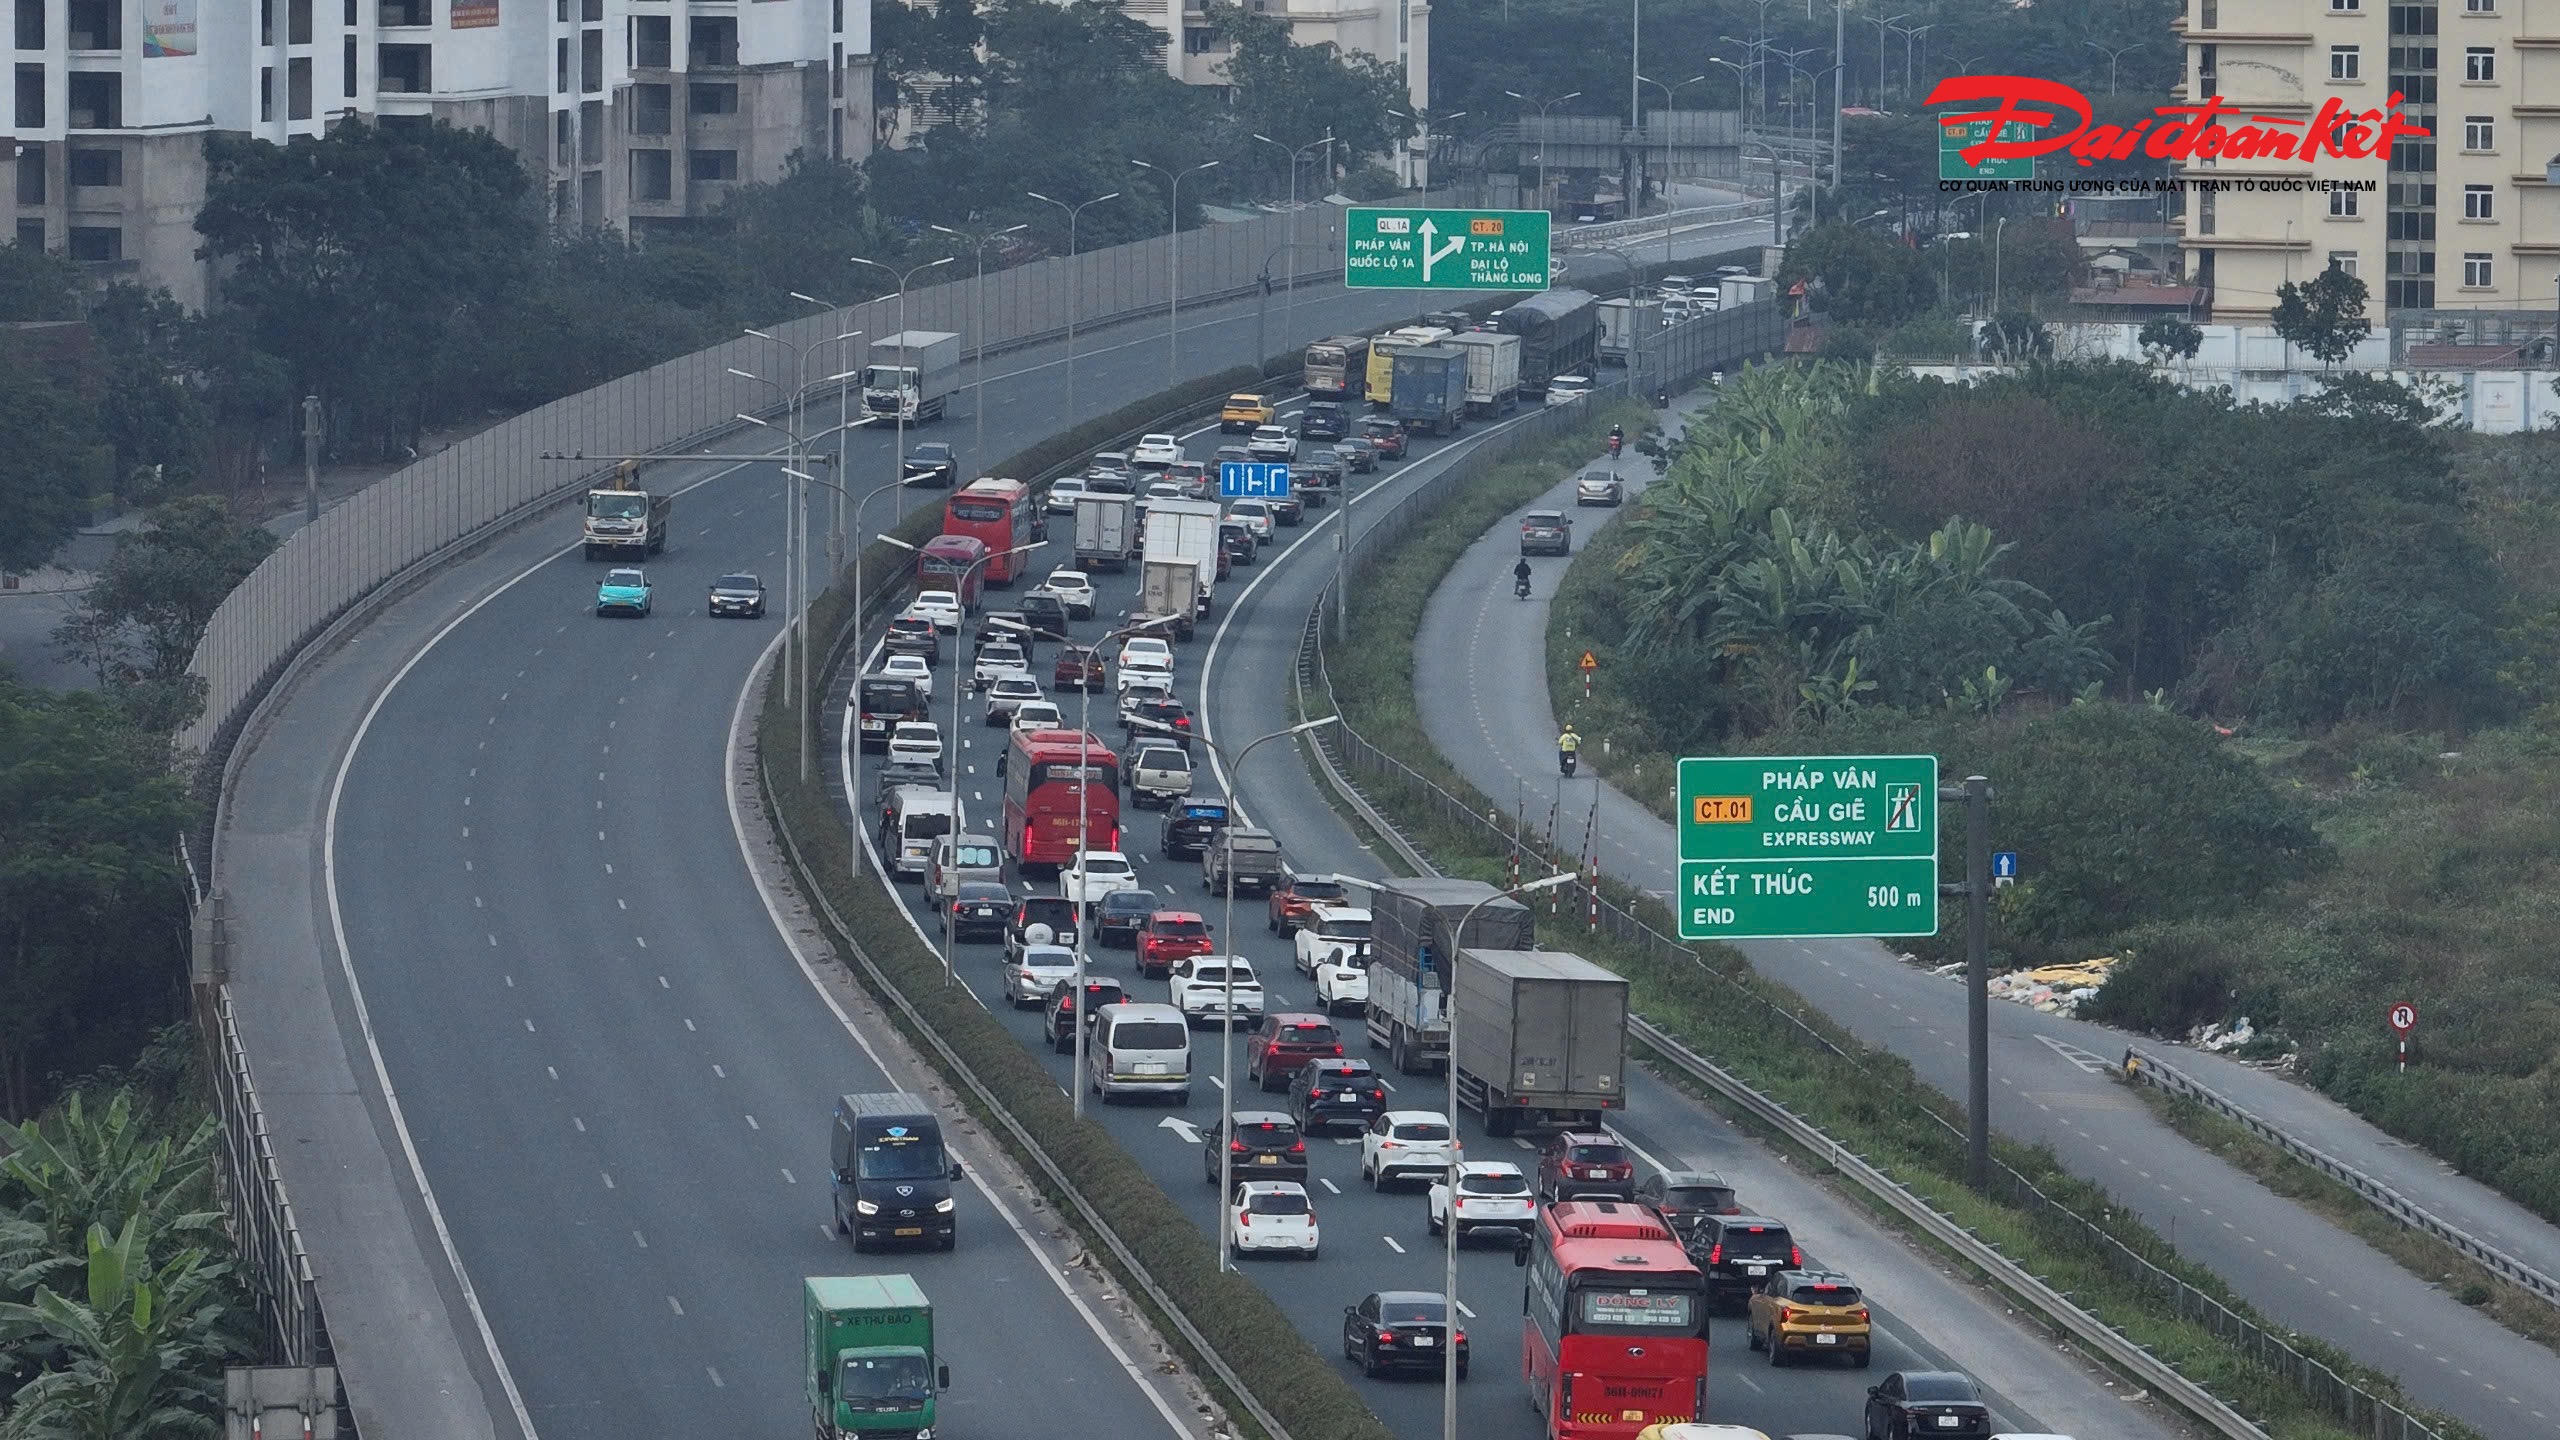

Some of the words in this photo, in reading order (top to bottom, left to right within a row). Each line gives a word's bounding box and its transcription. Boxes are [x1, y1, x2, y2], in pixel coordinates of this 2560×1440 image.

[1355, 237, 1385, 251] PHÁP
[1389, 237, 1411, 251] VÂN
[1509, 240, 1529, 256] NỘI
[1349, 253, 1381, 268] QUỐC
[1383, 255, 1398, 270] LỘ
[1401, 258, 1415, 268] 1A
[1471, 258, 1490, 272] ĐẠI
[1493, 256, 1509, 272] LỘ
[1471, 271, 1509, 283] THĂNG
[1512, 272, 1542, 284] LONG
[1762, 764, 1825, 790] PHÁP
[1832, 766, 1877, 790] VÂN
[1701, 801, 1747, 819] CT.01
[1774, 795, 1820, 823] CẦU
[1828, 797, 1866, 822] GIẼ
[1762, 830, 1876, 847] EXPRESSWAY
[1693, 865, 1740, 896] KẾT
[1750, 867, 1813, 895] THÚC
[1867, 885, 1899, 907] 500
[1906, 891, 1921, 907] m
[1693, 907, 1735, 925] END
[847, 1316, 860, 1326] XE
